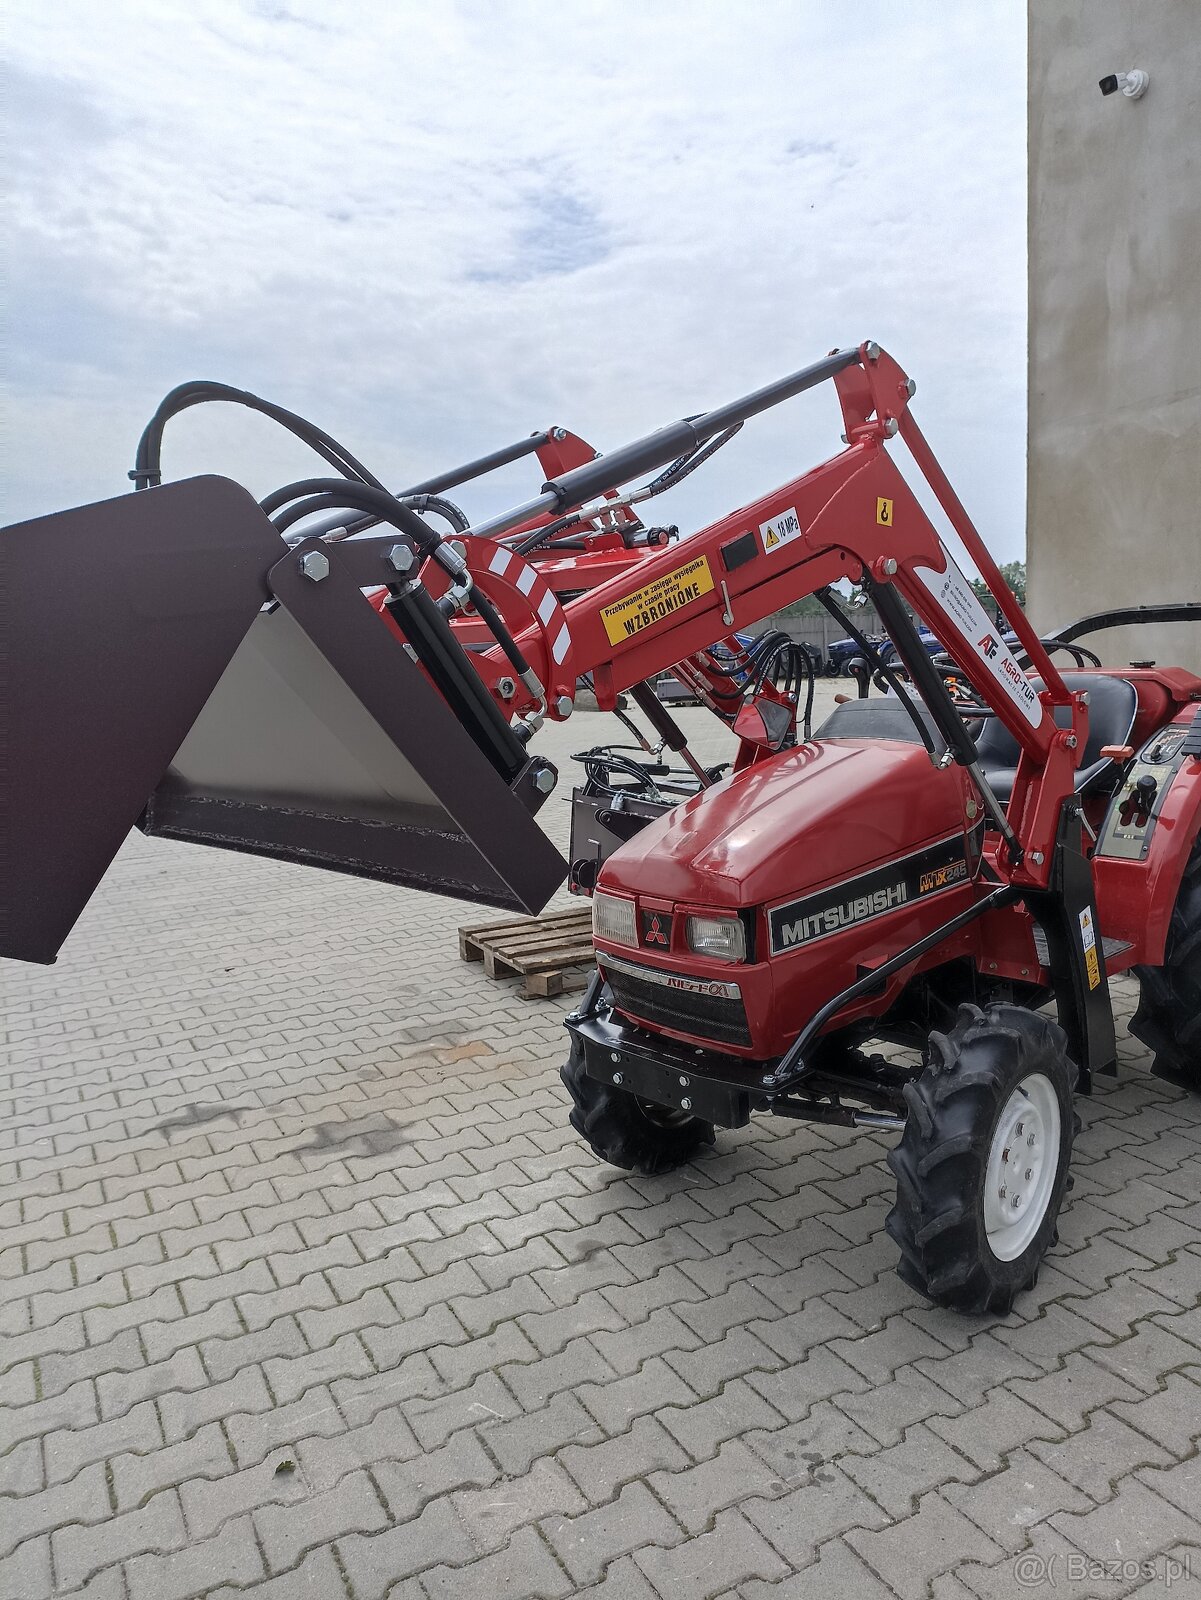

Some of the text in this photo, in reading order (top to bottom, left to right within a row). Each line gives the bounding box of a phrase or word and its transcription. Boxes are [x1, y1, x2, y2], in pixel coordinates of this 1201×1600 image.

[777, 515, 799, 538] 18 MPa
[604, 593, 643, 617] Przebywanie
[643, 589, 649, 597] w
[623, 582, 701, 635] WZBRONIONE
[644, 592, 663, 607] czasie
[663, 583, 680, 598] pracy
[1000, 657, 1035, 703] AGRO-TUR
[781, 881, 908, 946] MITSUBISHI
